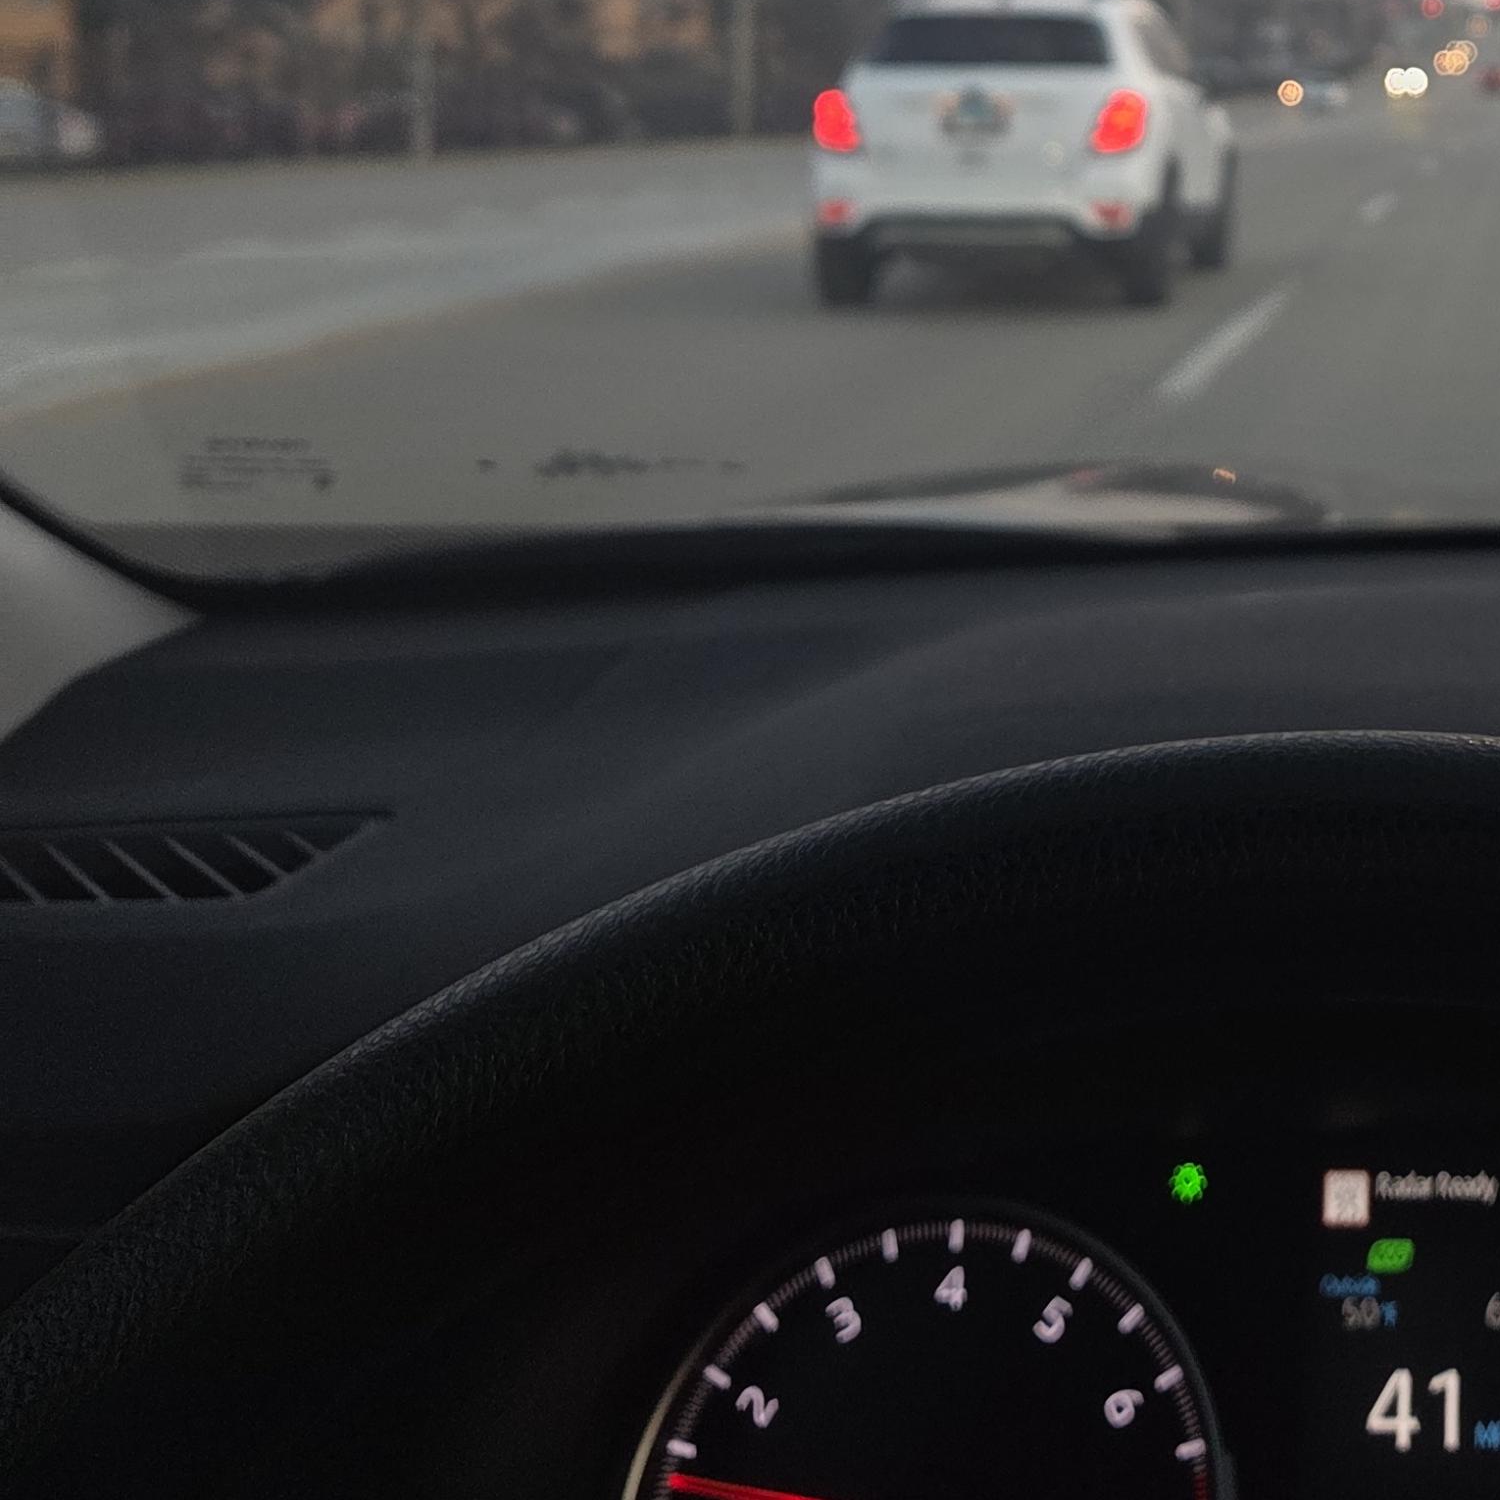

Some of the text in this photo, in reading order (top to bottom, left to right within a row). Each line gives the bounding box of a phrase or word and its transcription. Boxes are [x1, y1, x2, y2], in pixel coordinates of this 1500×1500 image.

[934, 1266, 967, 1311] 4
[825, 1297, 861, 1343] 3
[1032, 1296, 1073, 1343] 5
[736, 1386, 779, 1428] 2
[1104, 1389, 1144, 1428] 6
[1365, 1368, 1461, 1452] 41
